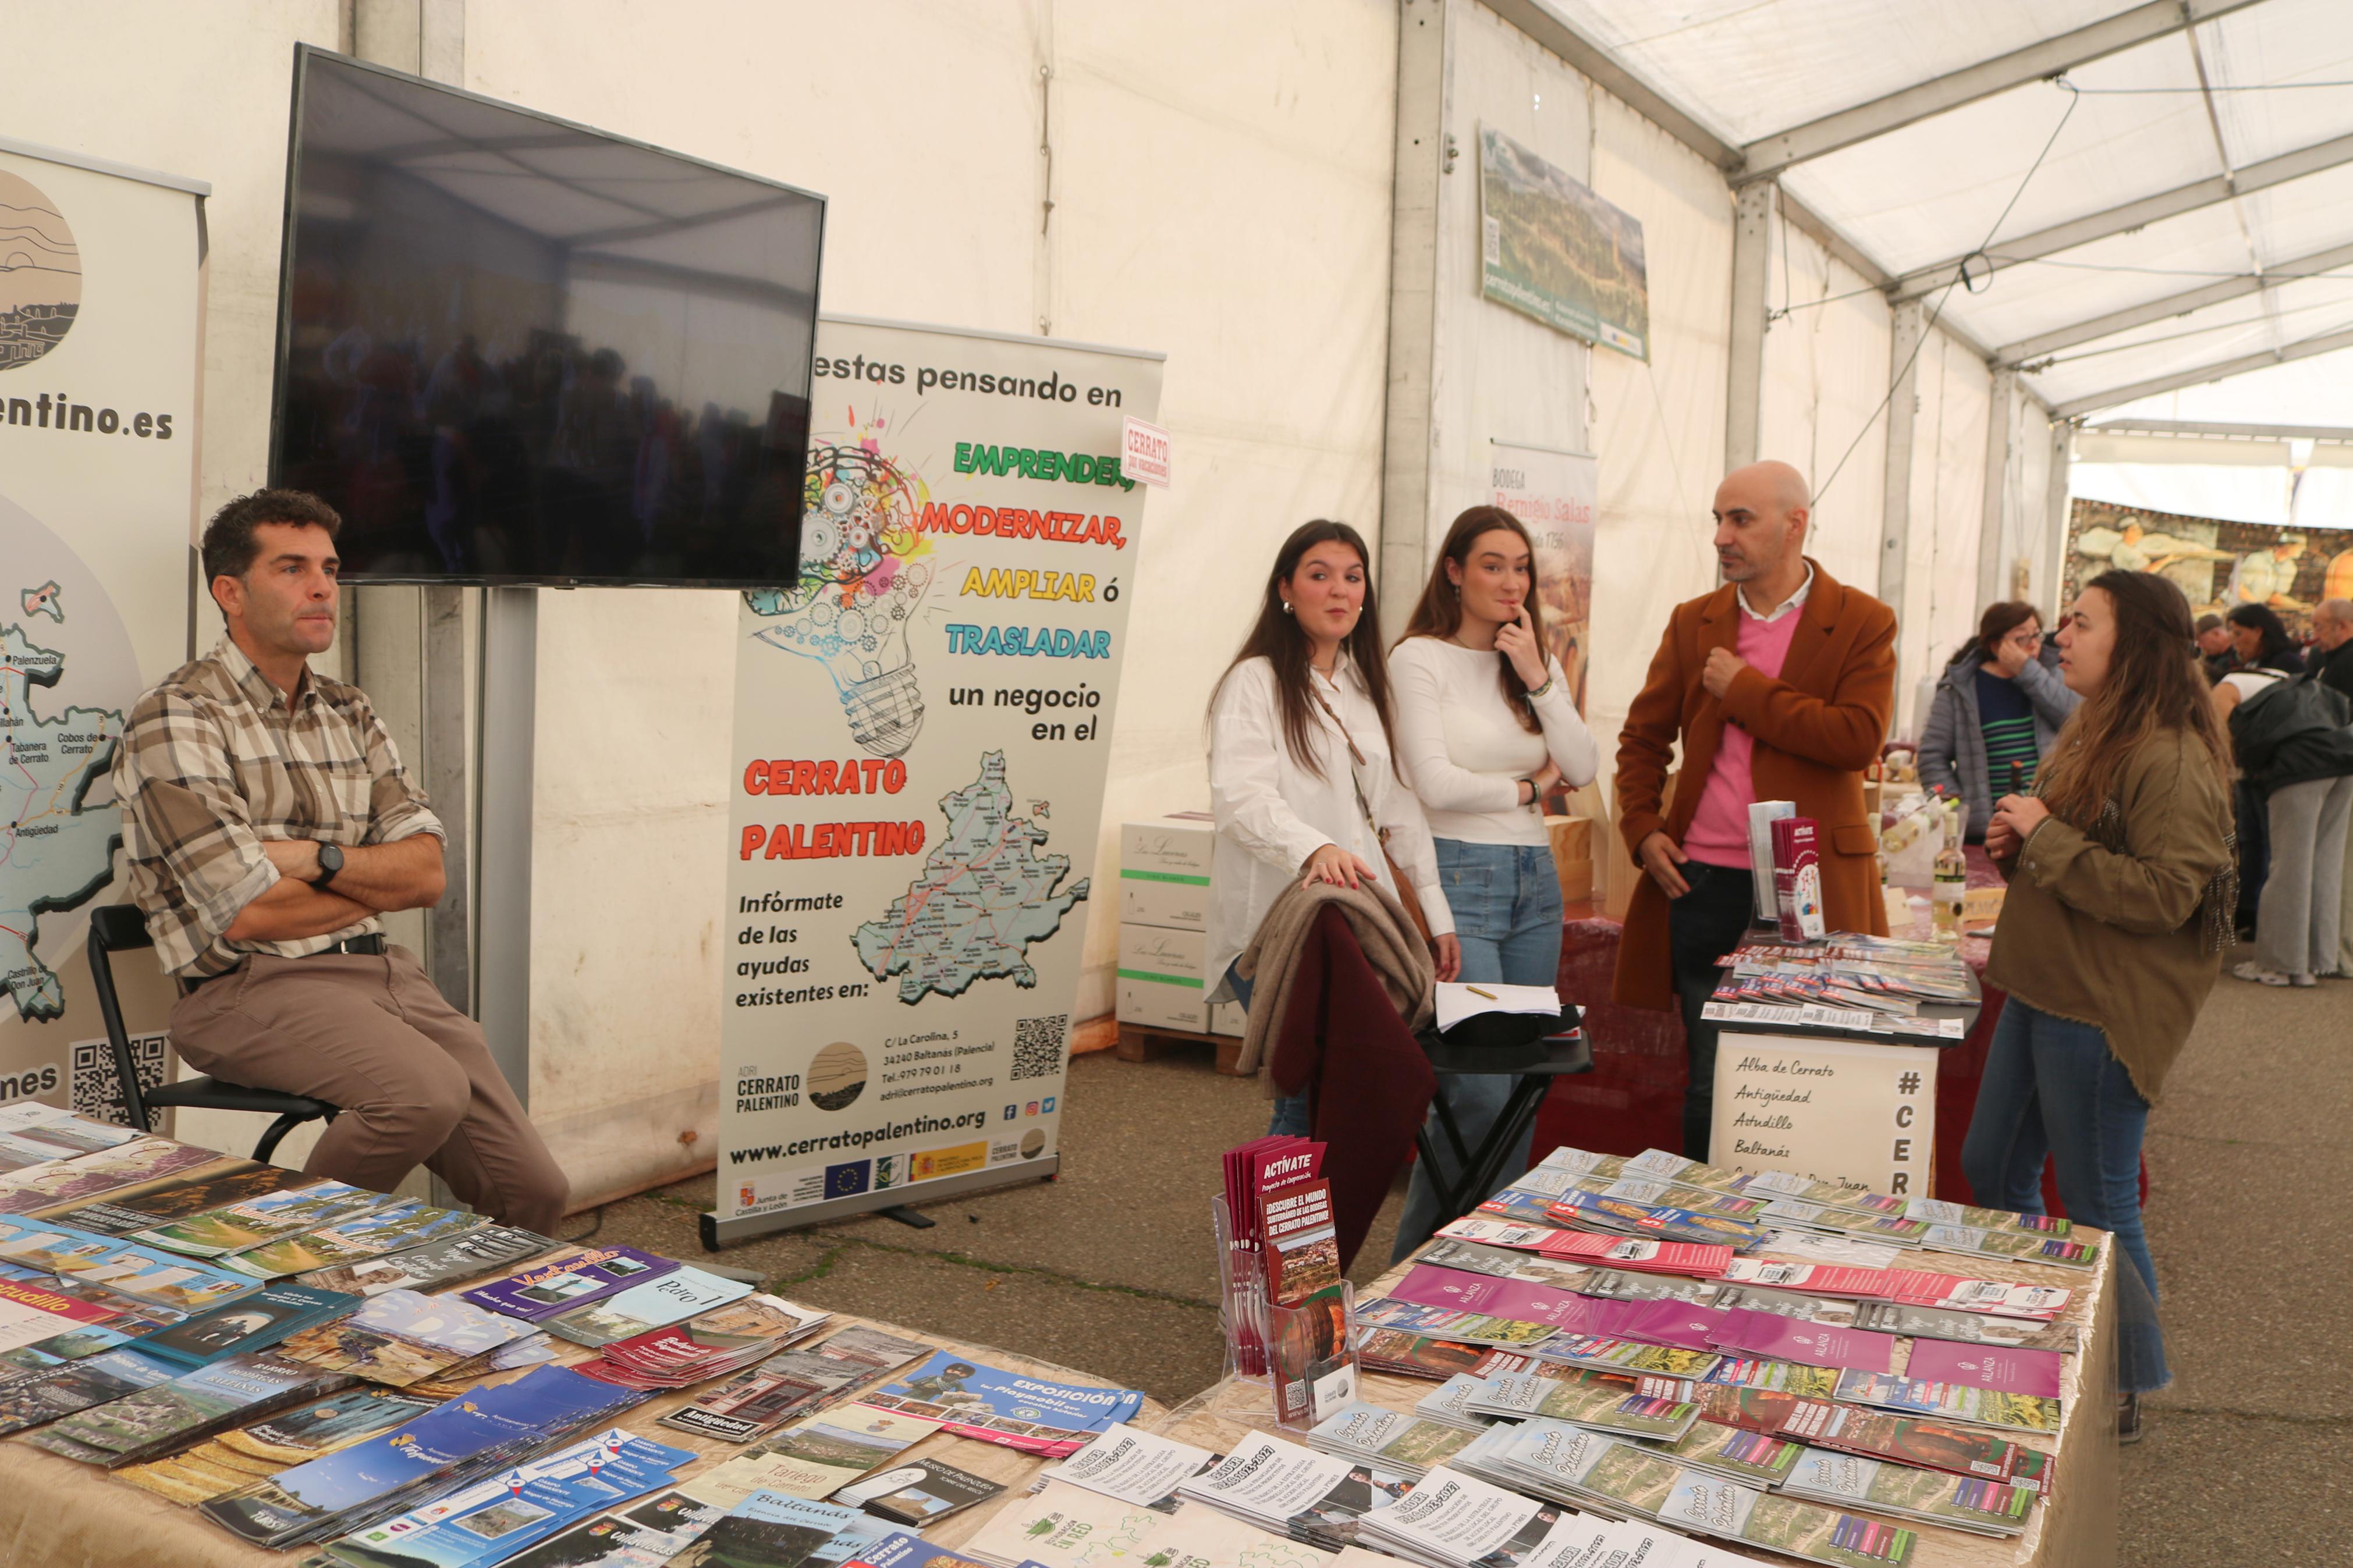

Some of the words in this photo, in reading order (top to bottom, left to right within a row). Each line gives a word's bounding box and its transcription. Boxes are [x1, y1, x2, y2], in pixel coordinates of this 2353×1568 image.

[814, 353, 906, 384] estas
[917, 371, 1077, 403] pensando
[1087, 386, 1122, 408] en
[0, 393, 173, 440] ntino.es
[1128, 429, 1167, 463] CERRATO
[954, 442, 1136, 492] EMPRENDER,
[1493, 468, 1525, 489] BODEGA
[1496, 491, 1550, 524] Remigio
[1555, 496, 1591, 524] Salas
[918, 502, 1127, 550] MODERNIZAR,
[960, 567, 1095, 602] AMPLIAR
[1103, 577, 1119, 602] ó
[945, 623, 1112, 659] TRASLADAR
[13, 655, 57, 665] Palenzuela
[949, 688, 984, 706] un
[995, 682, 1101, 715] negocio
[58, 733, 86, 743] Cobos
[87, 732, 98, 742] de
[1031, 723, 1066, 741] en
[1074, 713, 1097, 741] el
[9, 755, 18, 765] de
[20, 753, 49, 763] Cerrato
[12, 742, 47, 752] Tabanera
[61, 745, 93, 755] Cerrato
[743, 758, 907, 795] CERRATO
[15, 824, 59, 838] Antigüedad
[740, 820, 925, 861] PALENTINO
[739, 891, 843, 914] Infórmate
[738, 929, 766, 945] de
[768, 926, 797, 944] las
[8, 965, 37, 980] Castrillo
[737, 954, 810, 980] ayudas
[11, 980, 26, 991] Don
[27, 976, 45, 987] Juan
[736, 985, 834, 1008] existentes
[838, 982, 869, 1000] en:
[898, 1037, 908, 1047] La
[909, 1032, 950, 1044] Carolina,
[952, 1030, 959, 1040] 5
[883, 1053, 912, 1066] 34240
[914, 1050, 953, 1061] Baltanás
[953, 1041, 995, 1058] (Palencia)
[738, 1065, 758, 1078] ADRI
[919, 1066, 932, 1078] 79
[933, 1065, 945, 1076] 01
[949, 1064, 961, 1075] 18
[1736, 1056, 1769, 1073] Alba
[1773, 1059, 1788, 1074] de
[1790, 1060, 1834, 1077] Cerrato
[737, 1074, 800, 1097] CERRATO
[880, 1077, 994, 1102] adri@cerratopalentino.org
[1734, 1084, 1812, 1108] Antigüedad
[736, 1091, 800, 1114] PALENTINO
[1733, 1112, 1794, 1130] Astudillo
[729, 1110, 986, 1165] www.cerratopalentino.org
[1734, 1139, 1790, 1158] Baltanás
[1264, 1153, 1313, 1179] ACTÍVATE
[1262, 1181, 1280, 1193] Proyecto
[1286, 1171, 1312, 1185] Cooperación
[1837, 1176, 1871, 1192] Juan
[755, 1194, 777, 1205] Junta
[1266, 1196, 1298, 1215] ¡DESCUBRE
[1298, 1194, 1305, 1207] EL
[1305, 1188, 1326, 1204] MUNDO
[1266, 1208, 1297, 1225] SUBTERRÁNEO
[1296, 1207, 1303, 1216] DE
[1309, 1200, 1328, 1212] BODEGAS
[1269, 1225, 1279, 1237] DEL
[1279, 1218, 1301, 1233] CERRATO
[1301, 1210, 1329, 1228] PALENTINO!
[511, 1248, 621, 1287] Vertavillo
[0, 1283, 70, 1311] tudillo
[656, 1279, 698, 1303] Pedro
[1458, 1282, 1483, 1304] ARLANZA
[502, 1300, 516, 1310] que
[1545, 1299, 1573, 1321] ARLANZA
[1814, 1333, 1830, 1357] ARLANZA
[228, 1368, 283, 1385] BODEGAS
[252, 1363, 299, 1376] BARRIO
[1981, 1356, 1996, 1383] ARLANZA
[993, 1385, 1067, 1410] Playmobil
[1013, 1379, 1117, 1406] EXPOSICIÓN
[1488, 1377, 1515, 1403] Cerrato
[683, 1410, 754, 1432] Antigüedad
[1018, 1399, 1052, 1410] cuentan
[1052, 1407, 1088, 1419] historias
[1335, 1410, 1370, 1440] Cerrato
[1356, 1411, 1397, 1448] Palentino
[1096, 1437, 1137, 1471] 2023-2027
[1531, 1430, 1563, 1466] Cerrato
[1555, 1431, 1590, 1477] Palentino
[766, 1463, 828, 1485] Tariego
[1236, 1444, 1276, 1481] 2023-2027
[750, 1475, 764, 1485] de
[765, 1478, 812, 1494] Cerrato
[917, 1459, 945, 1475] MUSEO
[946, 1471, 954, 1480] DE
[953, 1472, 993, 1492] PALENZUELA
[756, 1494, 855, 1521] Baltanás
[1422, 1480, 1461, 1517] 2023-2027
[610, 1530, 677, 1557] Villaviudas
[1051, 1538, 1077, 1551] EN
[1074, 1522, 1094, 1539] RED
[864, 1537, 910, 1566] Cerrato
